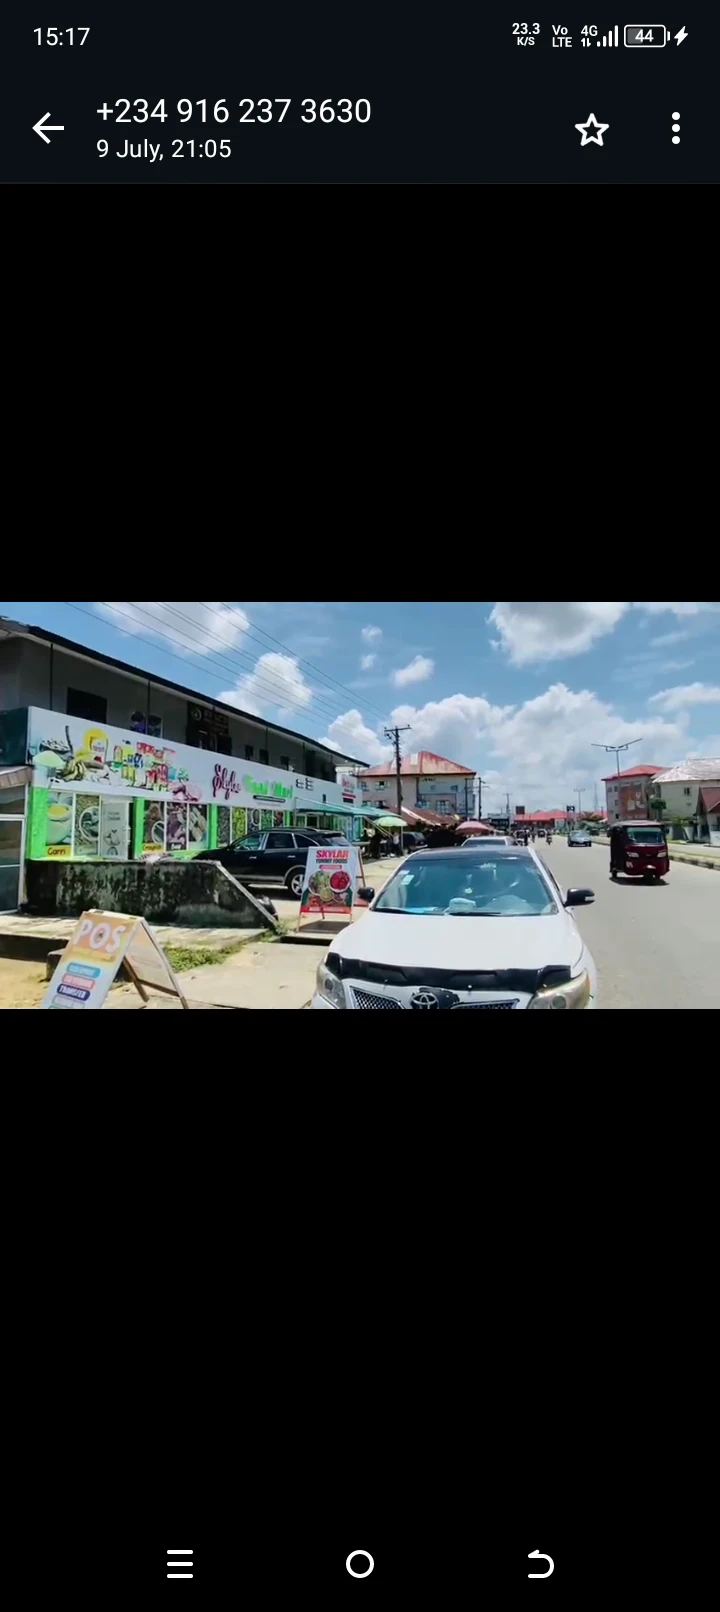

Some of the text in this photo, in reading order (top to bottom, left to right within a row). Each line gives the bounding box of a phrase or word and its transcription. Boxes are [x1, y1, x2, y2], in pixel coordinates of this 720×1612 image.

[512, 22, 541, 35] 23.3
[551, 25, 569, 36] Vo
[580, 25, 598, 37] 4G
[33, 27, 91, 47] 15:17
[516, 36, 536, 46] K/S
[634, 29, 654, 42] 44
[551, 37, 573, 48] LTE
[96, 98, 371, 124] +234 916 237 3630
[96, 138, 232, 163] 9 July, 21:05
[316, 850, 349, 858] SKYLAR
[73, 919, 127, 953] POS
